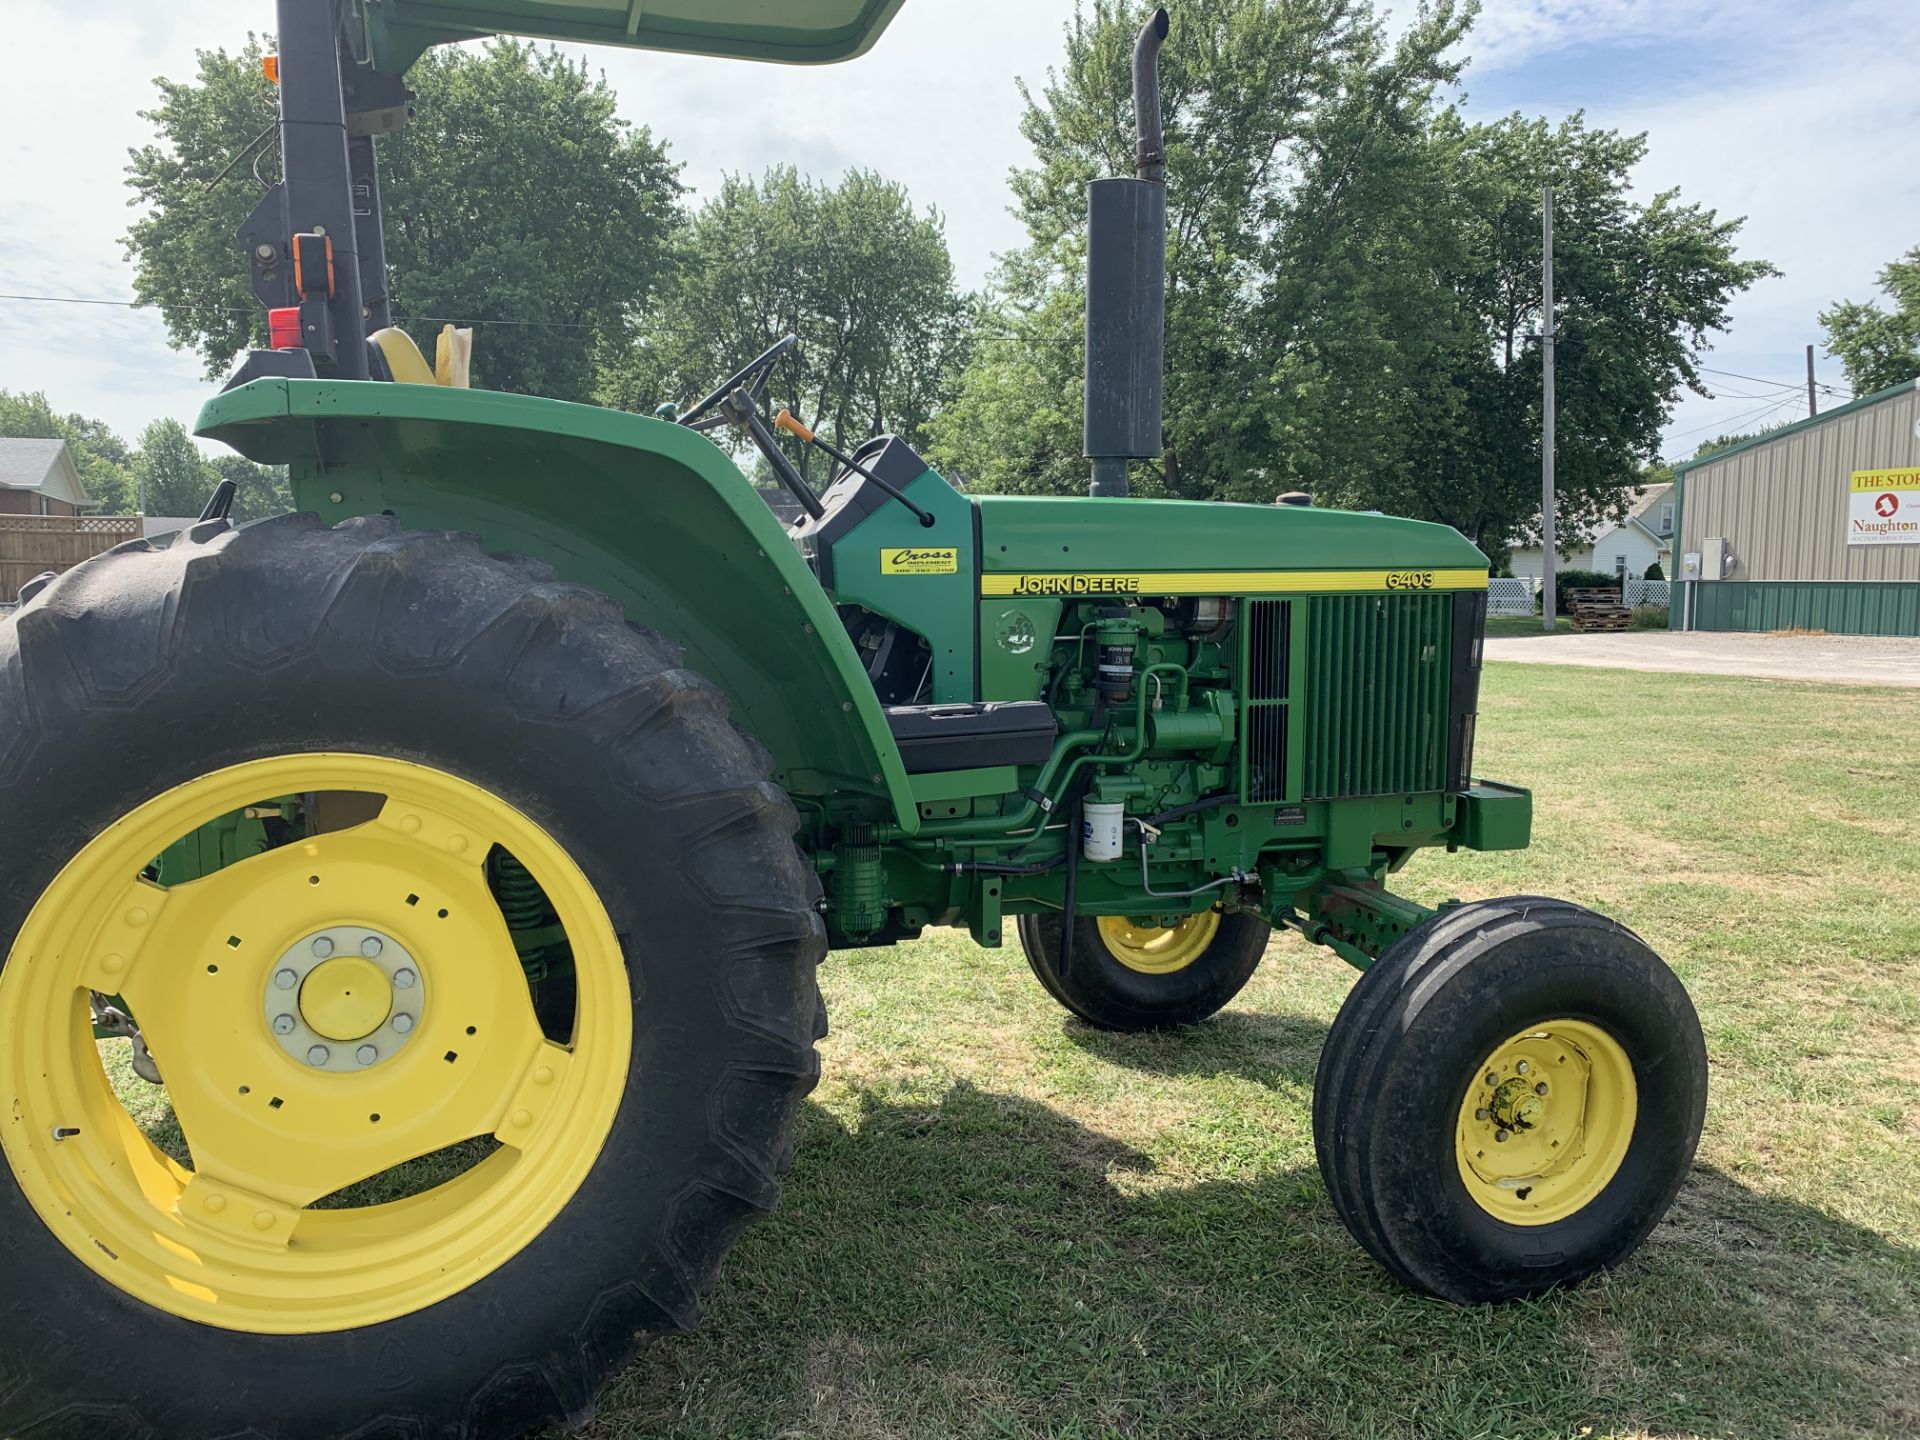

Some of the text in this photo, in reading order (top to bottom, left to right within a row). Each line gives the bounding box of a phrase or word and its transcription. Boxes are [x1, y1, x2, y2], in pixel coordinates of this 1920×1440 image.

[1855, 475, 1884, 488] THE
[1853, 519, 1918, 535] Naughton
[892, 549, 953, 565] Cross
[1012, 575, 1139, 594] JOHN DEERE
[1386, 571, 1434, 589] 6403
